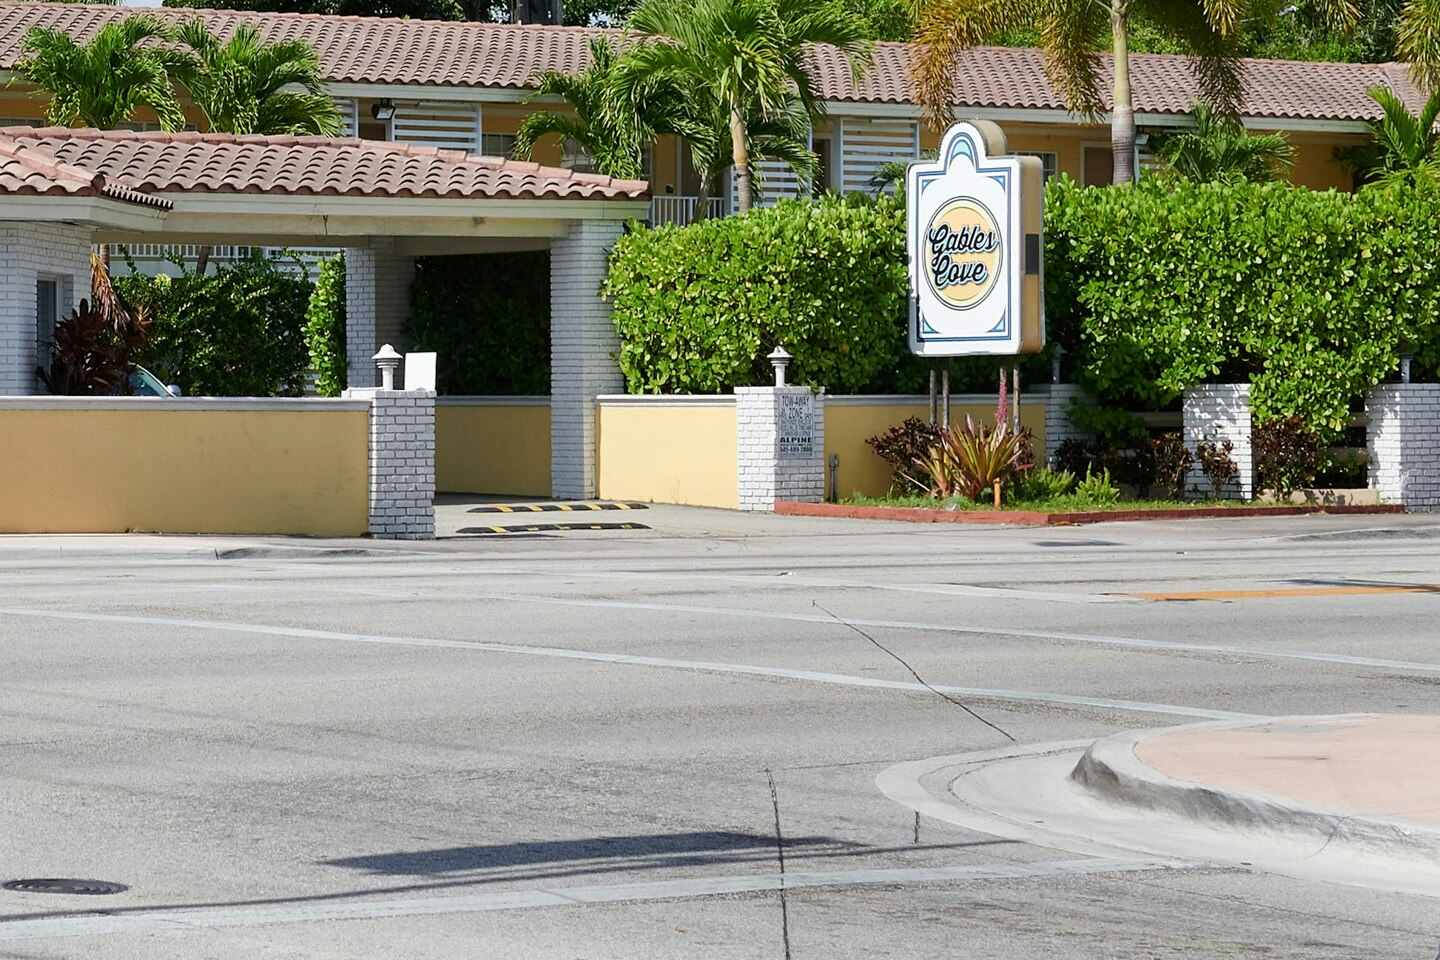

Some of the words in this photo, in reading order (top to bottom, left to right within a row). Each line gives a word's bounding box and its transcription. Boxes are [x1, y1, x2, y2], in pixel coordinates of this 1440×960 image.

[928, 223, 998, 268] Gables
[933, 254, 987, 288] Cove
[788, 407, 803, 419] ZONE
